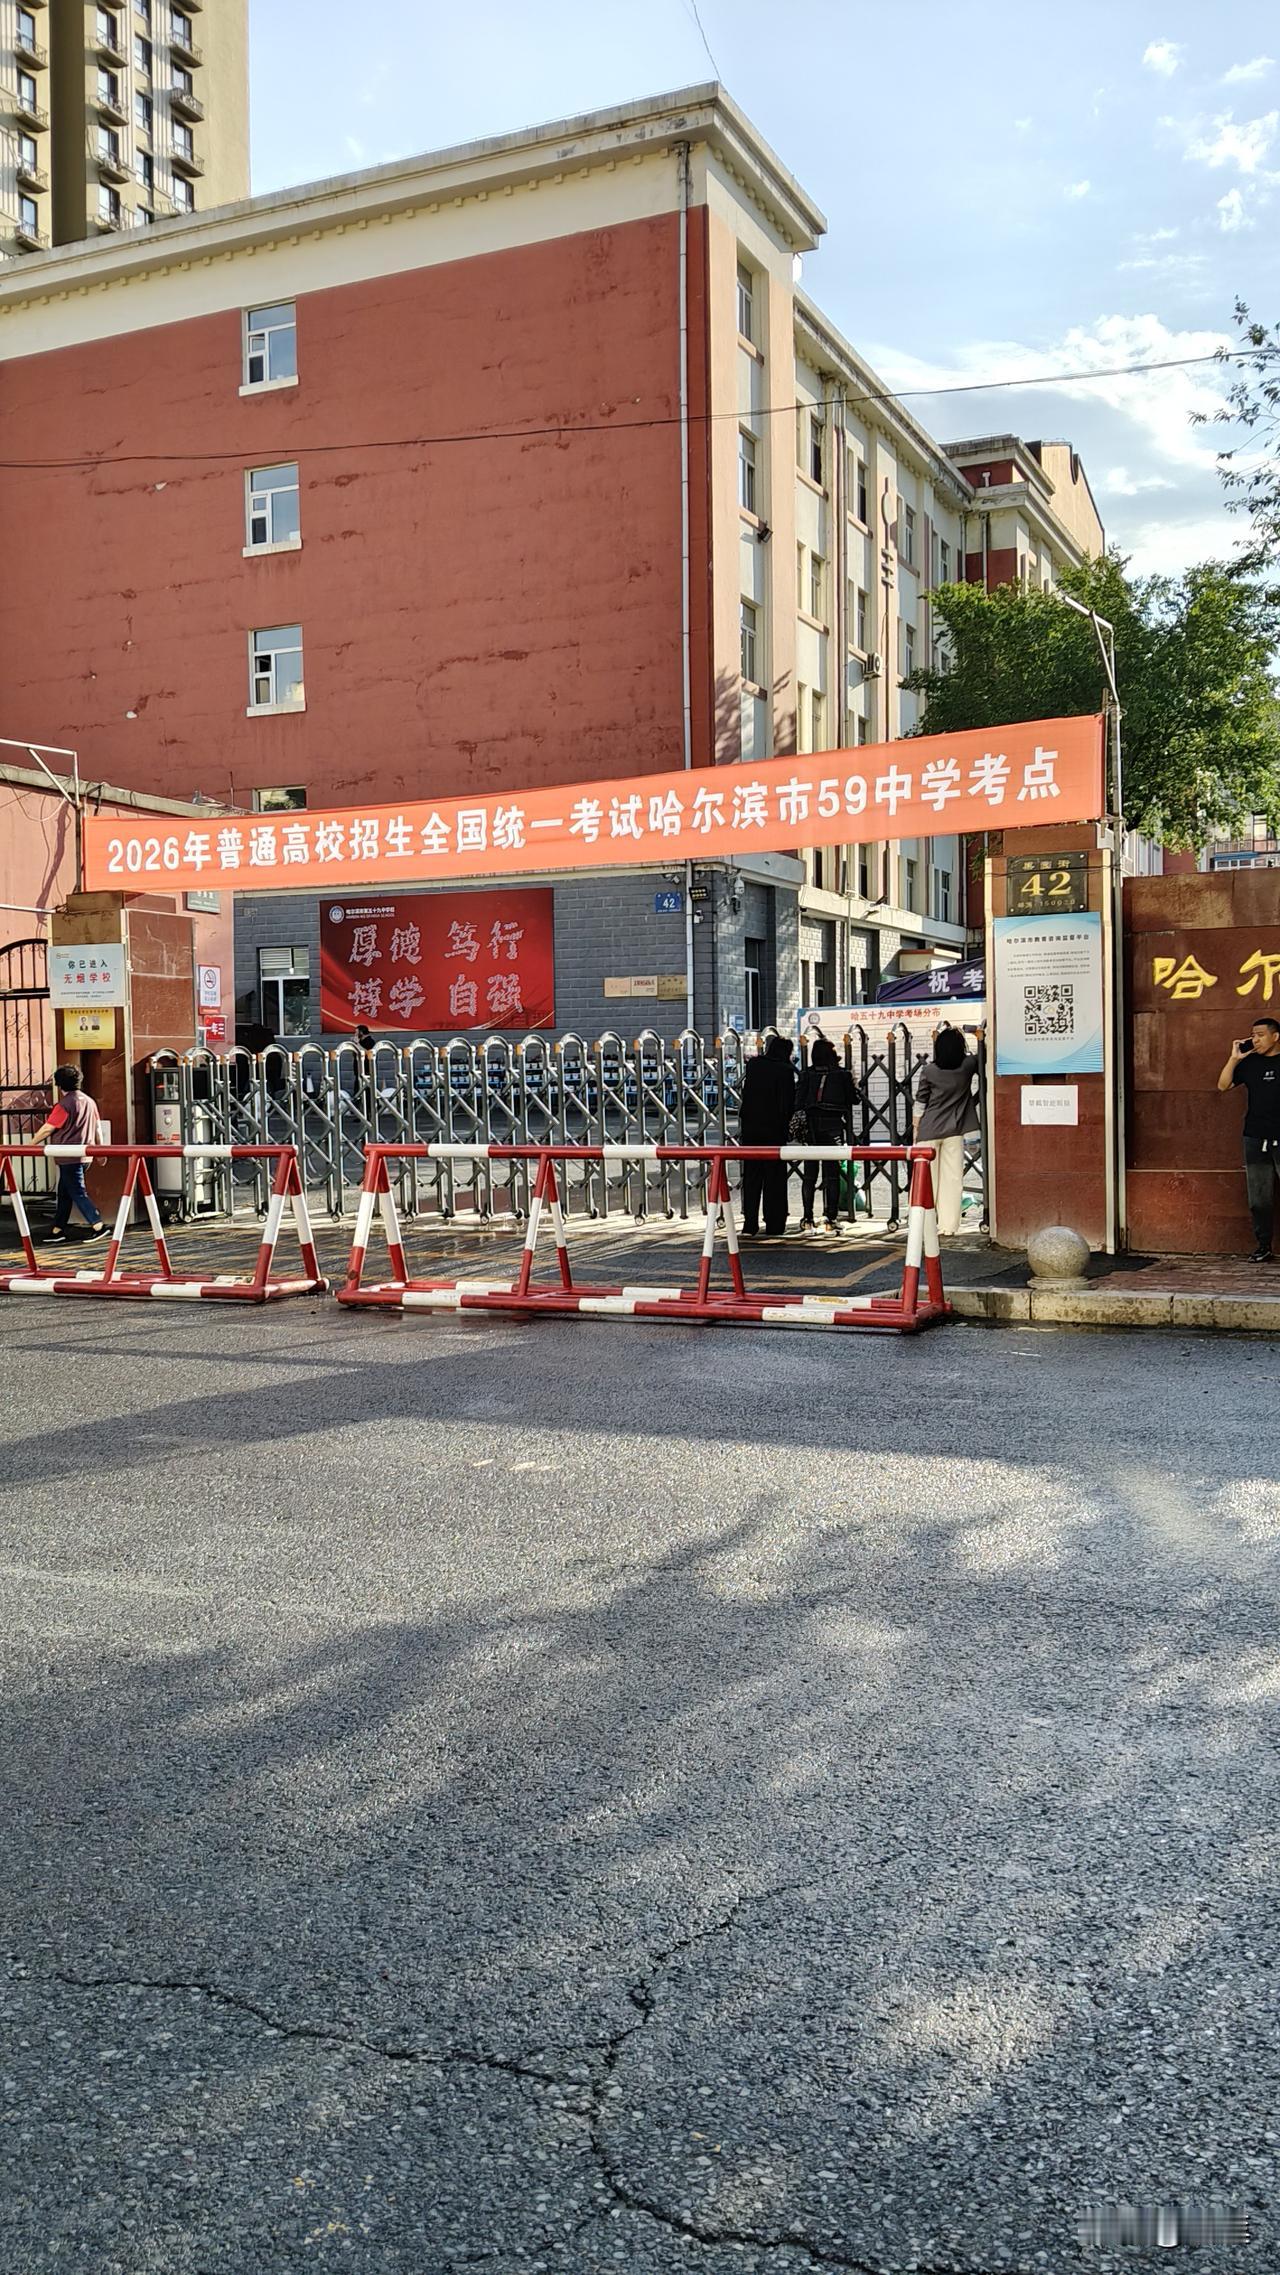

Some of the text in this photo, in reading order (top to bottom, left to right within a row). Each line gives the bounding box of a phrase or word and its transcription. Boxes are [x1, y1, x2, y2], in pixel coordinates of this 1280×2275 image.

[107, 745, 1061, 874] 2026年普通高校招生全国统一考试哈尔滨市59中学考点
[1021, 871, 1072, 897] 42
[662, 898, 676, 908] 42
[850, 1007, 941, 1021] 哈五十九中学考场分布
